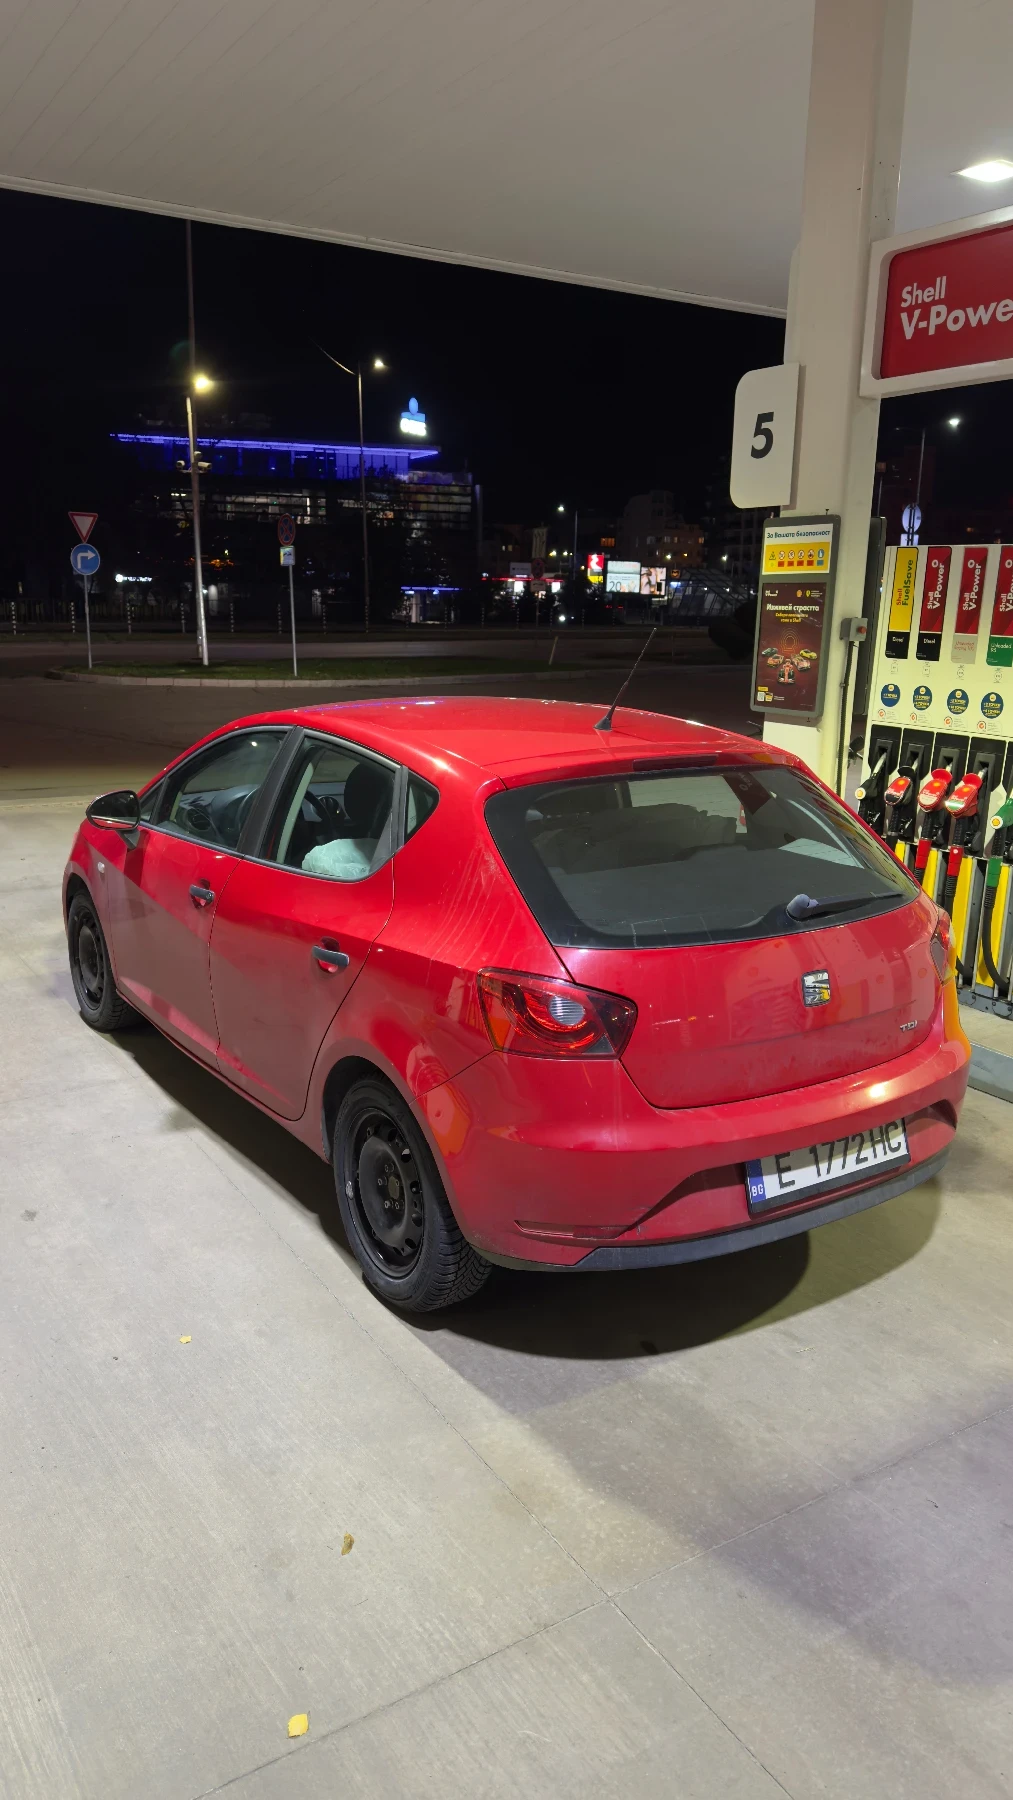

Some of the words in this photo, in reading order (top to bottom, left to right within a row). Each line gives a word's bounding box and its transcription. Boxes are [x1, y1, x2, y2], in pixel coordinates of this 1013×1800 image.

[900, 275, 947, 308] Shell
[900, 299, 1013, 340] V-Powe
[751, 411, 774, 459] 5
[902, 559, 914, 606] FuelSave
[927, 591, 935, 609] Shell
[932, 563, 945, 609] V-Power
[968, 563, 982, 611] V-Power
[900, 1020, 917, 1032] TDI
[752, 1184, 764, 1197] BG
[774, 1152, 796, 1190] E
